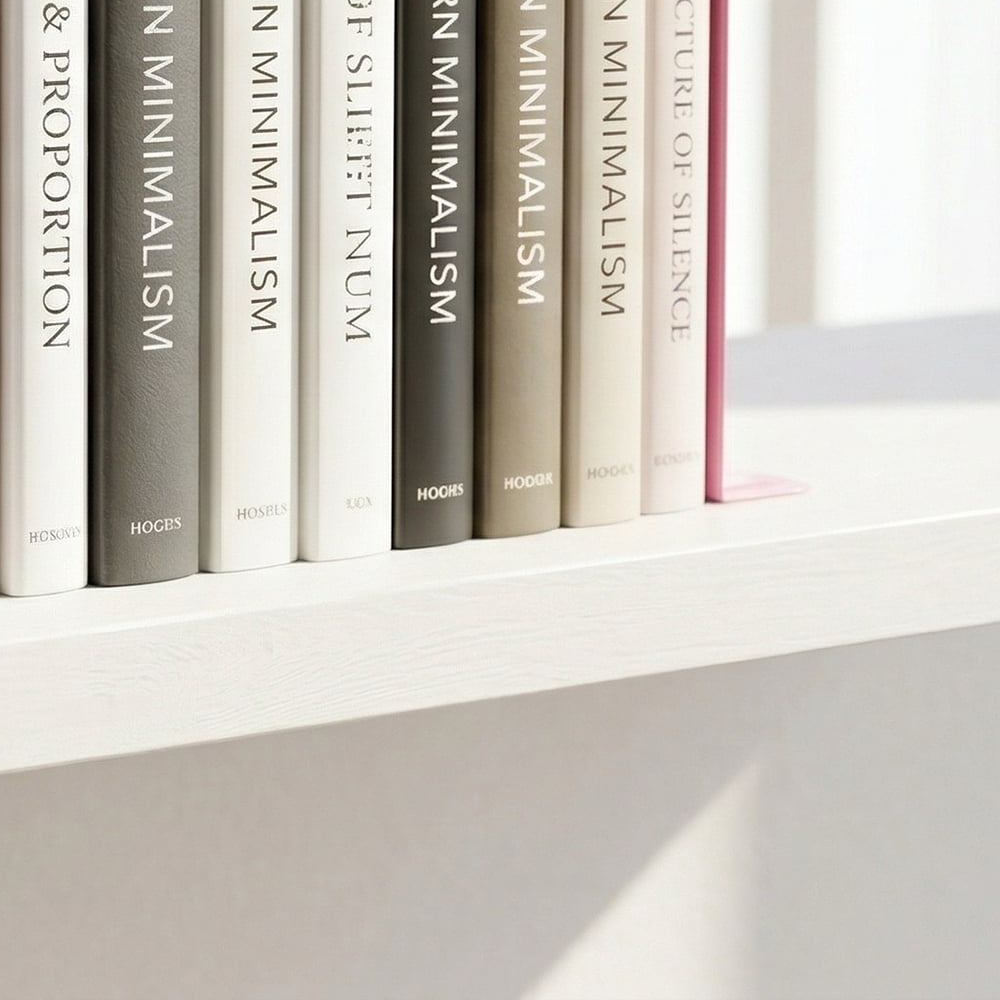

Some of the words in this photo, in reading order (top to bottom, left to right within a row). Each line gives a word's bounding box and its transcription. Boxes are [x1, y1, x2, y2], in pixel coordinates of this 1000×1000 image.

[43, 3, 72, 34] &
[43, 50, 73, 349] PROPORTION
[143, 56, 175, 352] MINIMALISM
[251, 51, 280, 333] MINIMALISM
[345, 229, 373, 344] NUM
[430, 57, 461, 325] MINIMALISM
[517, 29, 548, 306] MINIMALISM
[601, 41, 629, 317] MINIMALISM
[672, 193, 693, 343] SILENCE
[674, 133, 693, 178] OF
